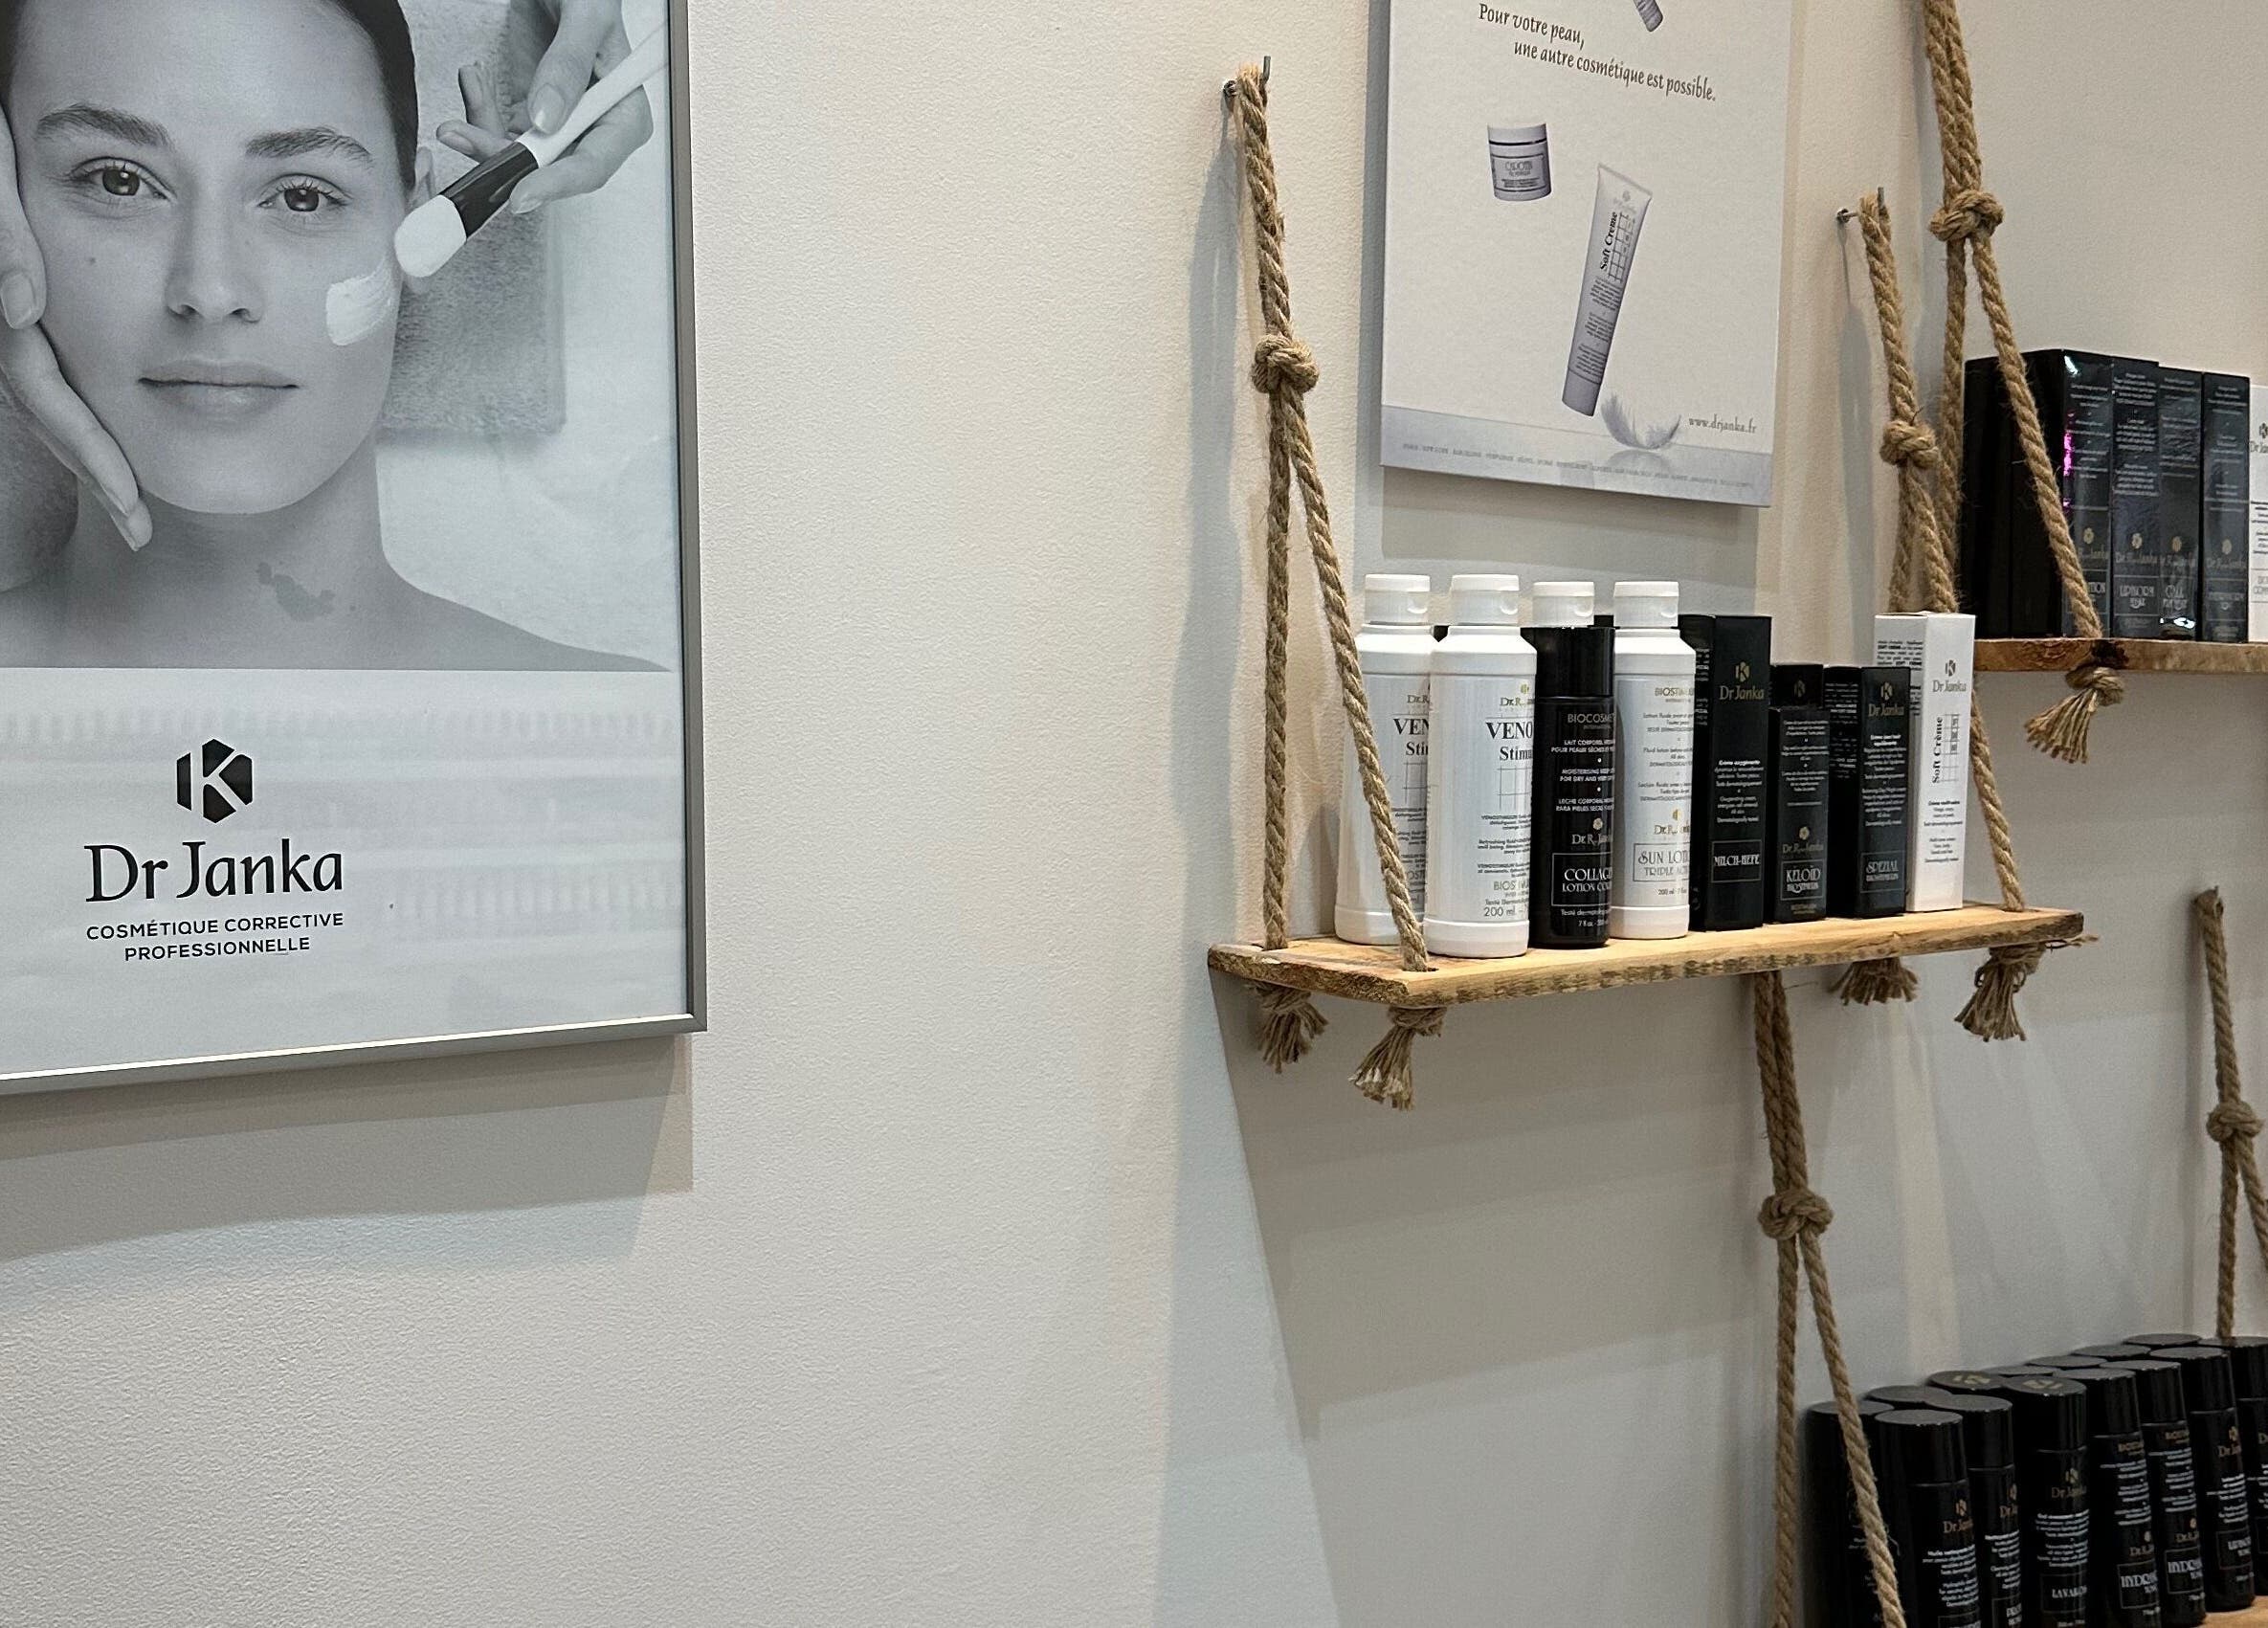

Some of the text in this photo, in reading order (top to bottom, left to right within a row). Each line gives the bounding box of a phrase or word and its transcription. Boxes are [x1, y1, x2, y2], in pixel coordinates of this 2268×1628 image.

[1479, 3, 1585, 51] Pour votre peau,
[1514, 41, 1716, 101] une autre cosmétique est possible.
[1687, 413, 1758, 435] www.drjanka.fr
[1719, 685, 1765, 701] Dr Janka
[1485, 721, 1533, 740] VENO
[83, 837, 344, 903] Dr Janka
[1483, 906, 1504, 918] 200
[86, 912, 345, 941] COSMÉTIQUE CORRECTIVE
[124, 936, 311, 962] PROFESSIONNELLE
